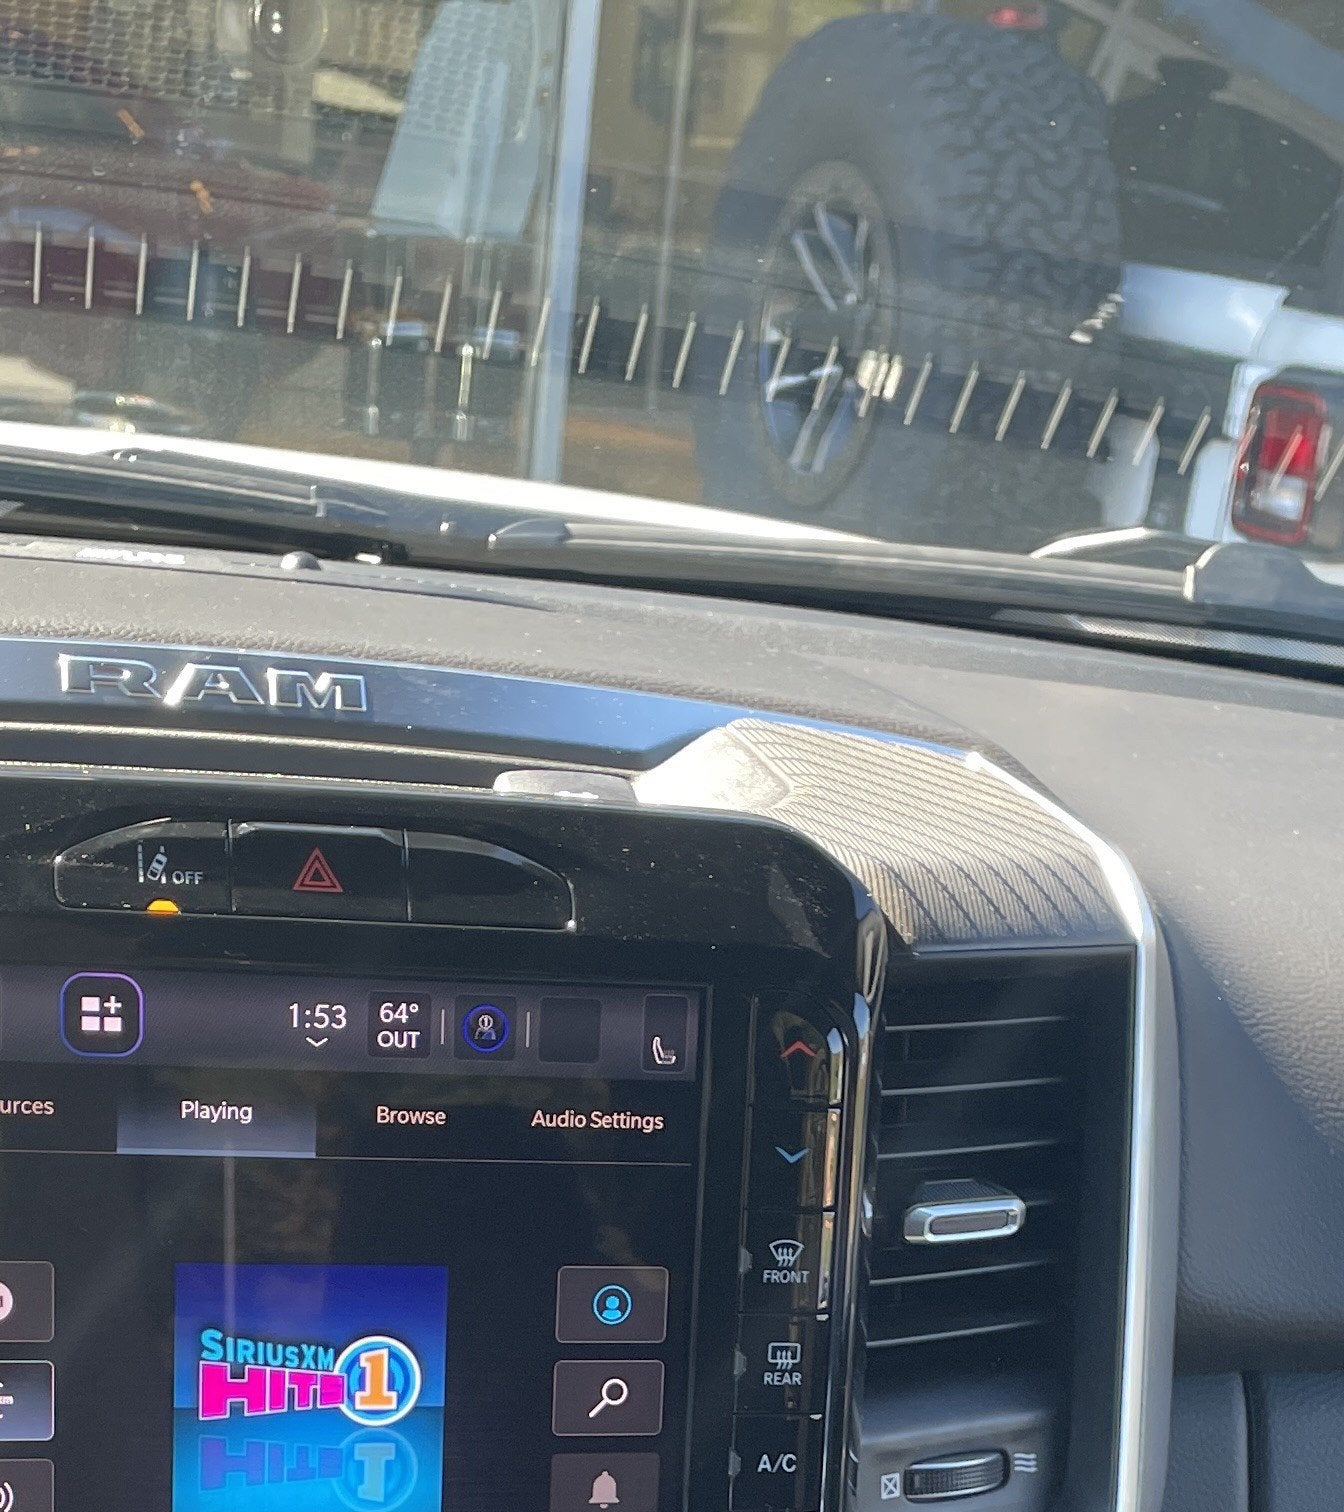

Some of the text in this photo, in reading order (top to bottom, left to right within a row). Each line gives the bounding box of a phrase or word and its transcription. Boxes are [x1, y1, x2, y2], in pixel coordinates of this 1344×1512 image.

[58, 653, 369, 714] RAM
[171, 870, 204, 886] OFF
[288, 1002, 347, 1030] 1:53
[376, 1030, 420, 1049] OUT
[180, 1100, 253, 1124] Playing
[376, 1105, 447, 1126] Browse
[531, 1109, 665, 1134] Audio Settings
[763, 1269, 810, 1285] FRONT
[198, 1347, 399, 1421] HITS 1
[763, 1371, 802, 1387] REAR
[757, 1453, 797, 1473] A/C
